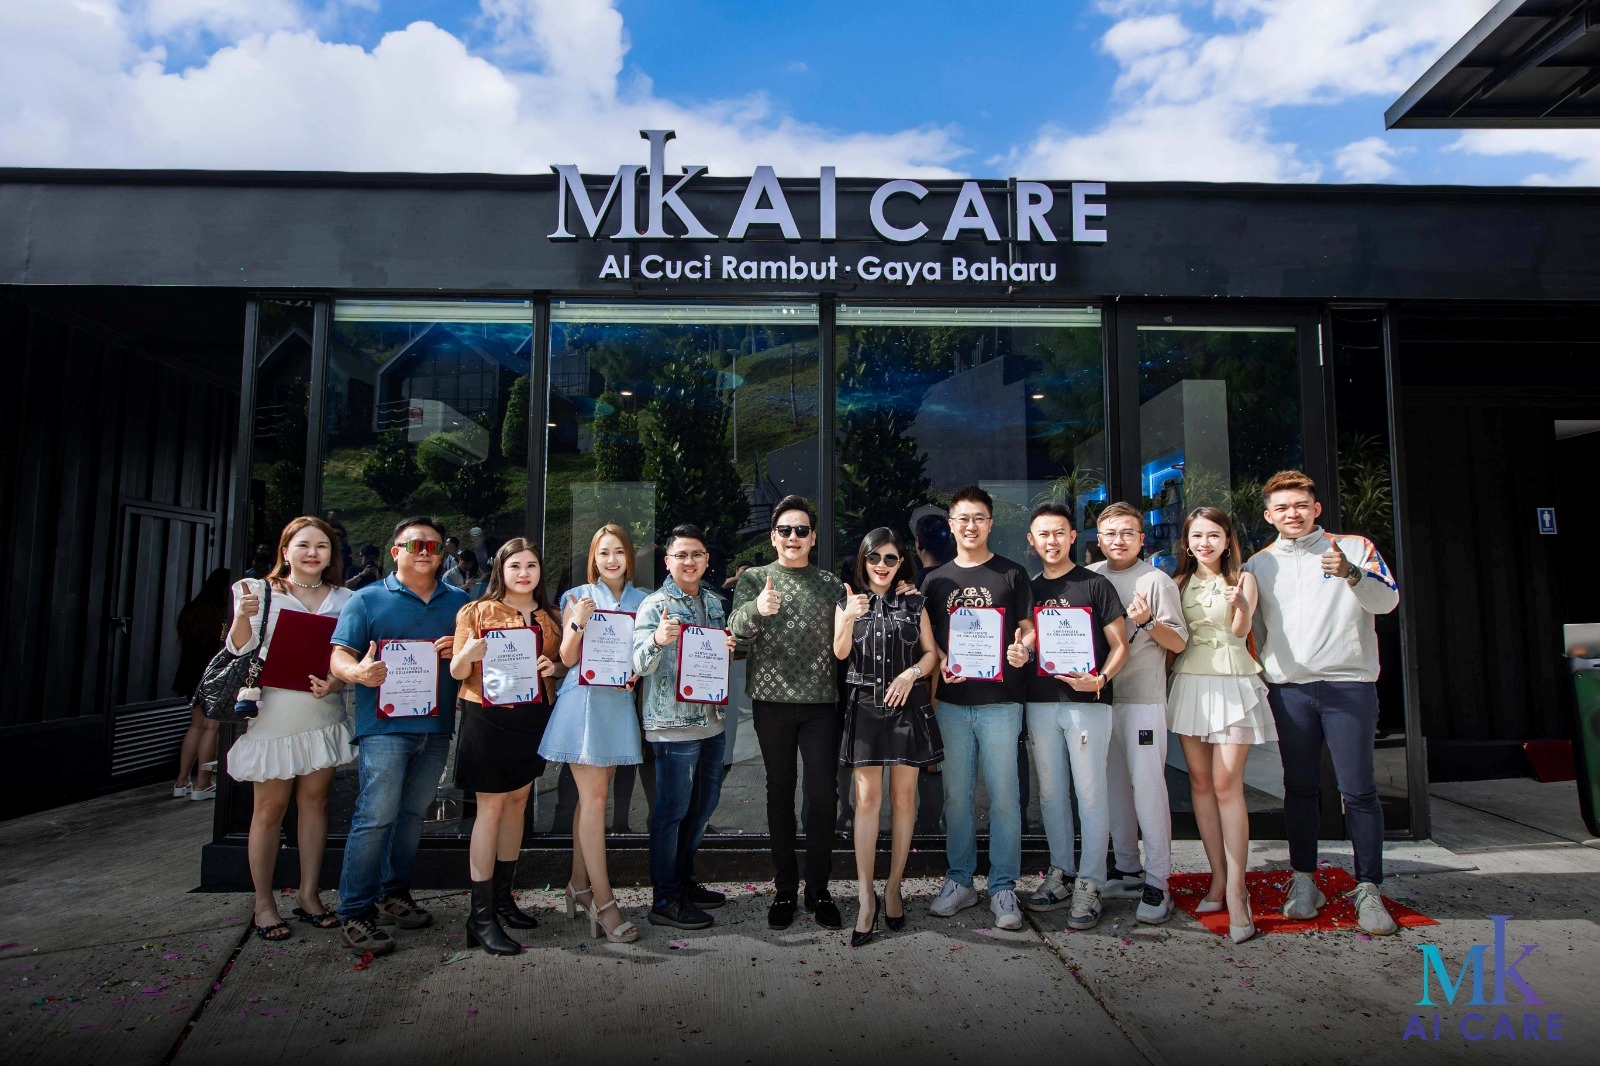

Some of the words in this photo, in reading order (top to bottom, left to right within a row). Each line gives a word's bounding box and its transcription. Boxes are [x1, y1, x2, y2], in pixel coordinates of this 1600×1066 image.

[727, 165, 837, 242] AI
[869, 179, 1108, 245] CARE
[599, 255, 630, 280] AI
[640, 254, 711, 281] Cuci
[722, 255, 838, 281] Rambut
[857, 256, 939, 287] Gaya
[952, 257, 1057, 283] Baharu
